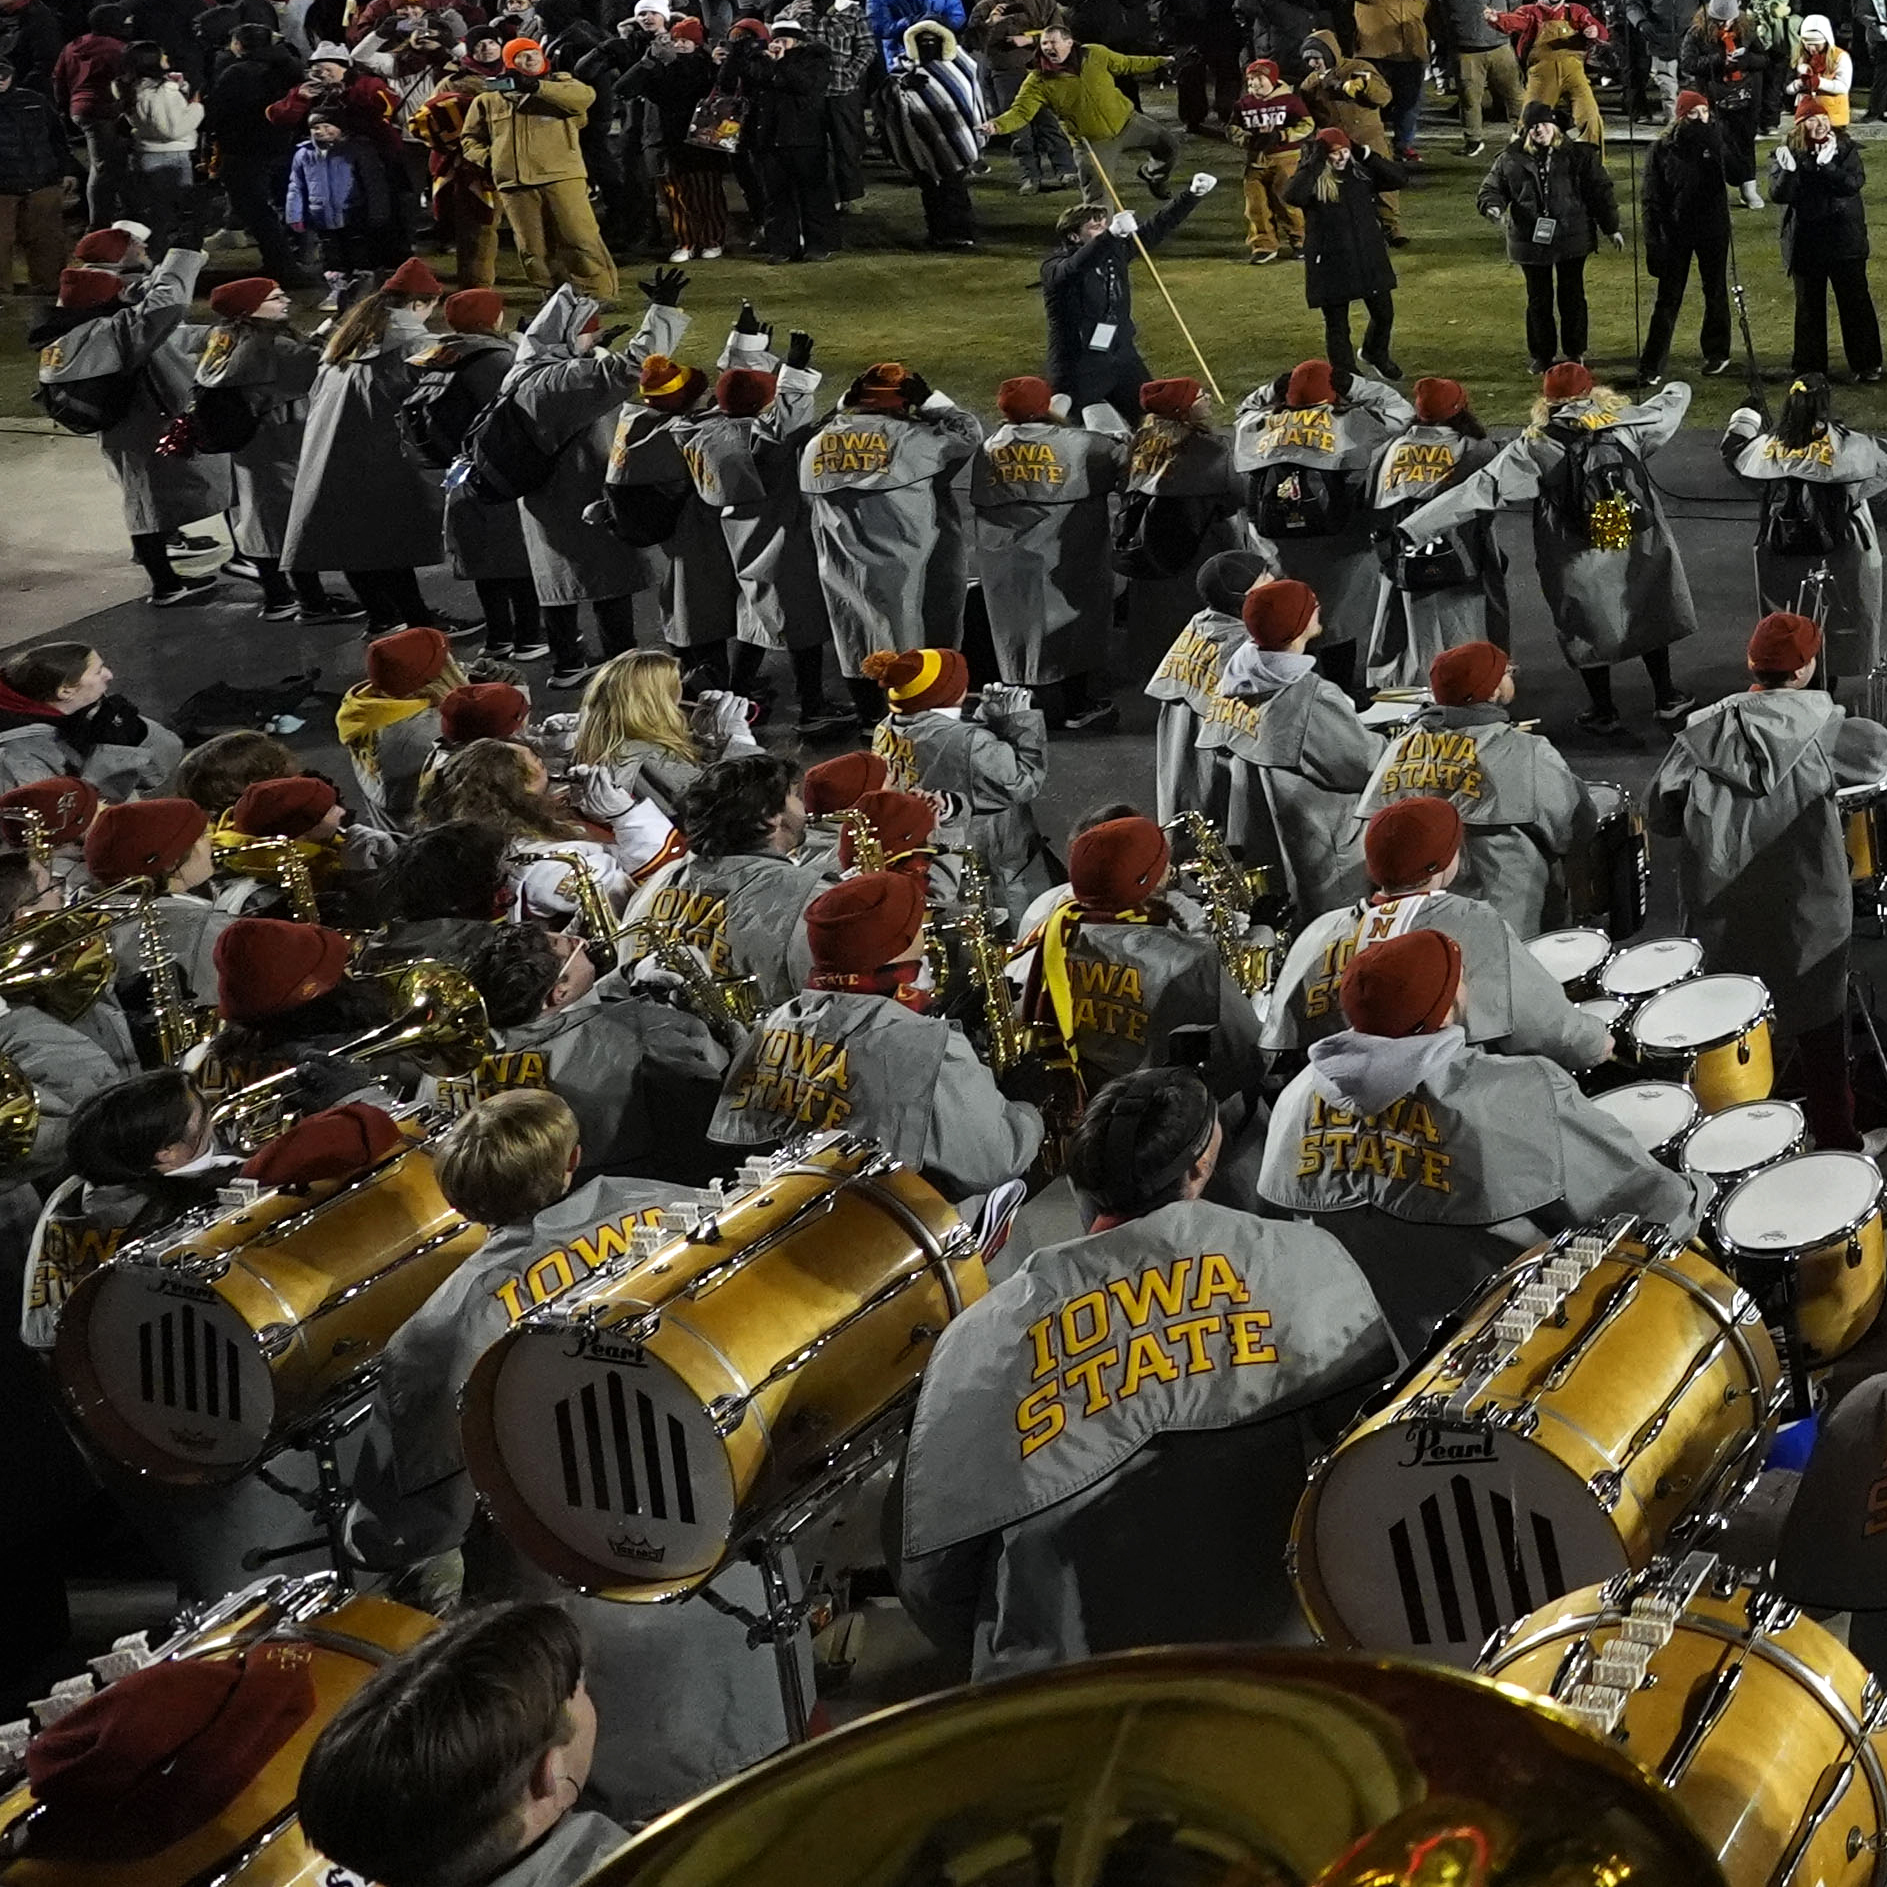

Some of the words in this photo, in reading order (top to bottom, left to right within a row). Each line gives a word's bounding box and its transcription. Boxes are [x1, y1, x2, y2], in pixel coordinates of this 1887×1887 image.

[812, 448, 889, 478] STATE
[1257, 426, 1336, 455] STATE
[1203, 693, 1262, 740] STATE
[1402, 729, 1478, 765] IOWA
[1381, 758, 1482, 800] STATE
[631, 924, 734, 977] SATE
[758, 1025, 851, 1091] IOWA
[729, 1070, 855, 1133] STATE
[1308, 1089, 1440, 1146] IOWA
[1296, 1128, 1455, 1194] STATE
[495, 1208, 675, 1323] IOW
[562, 1318, 649, 1369] Pearl
[1028, 1251, 1250, 1383] IOWA
[1014, 1309, 1279, 1458] STATE
[1397, 1417, 1500, 1468] Pearl
